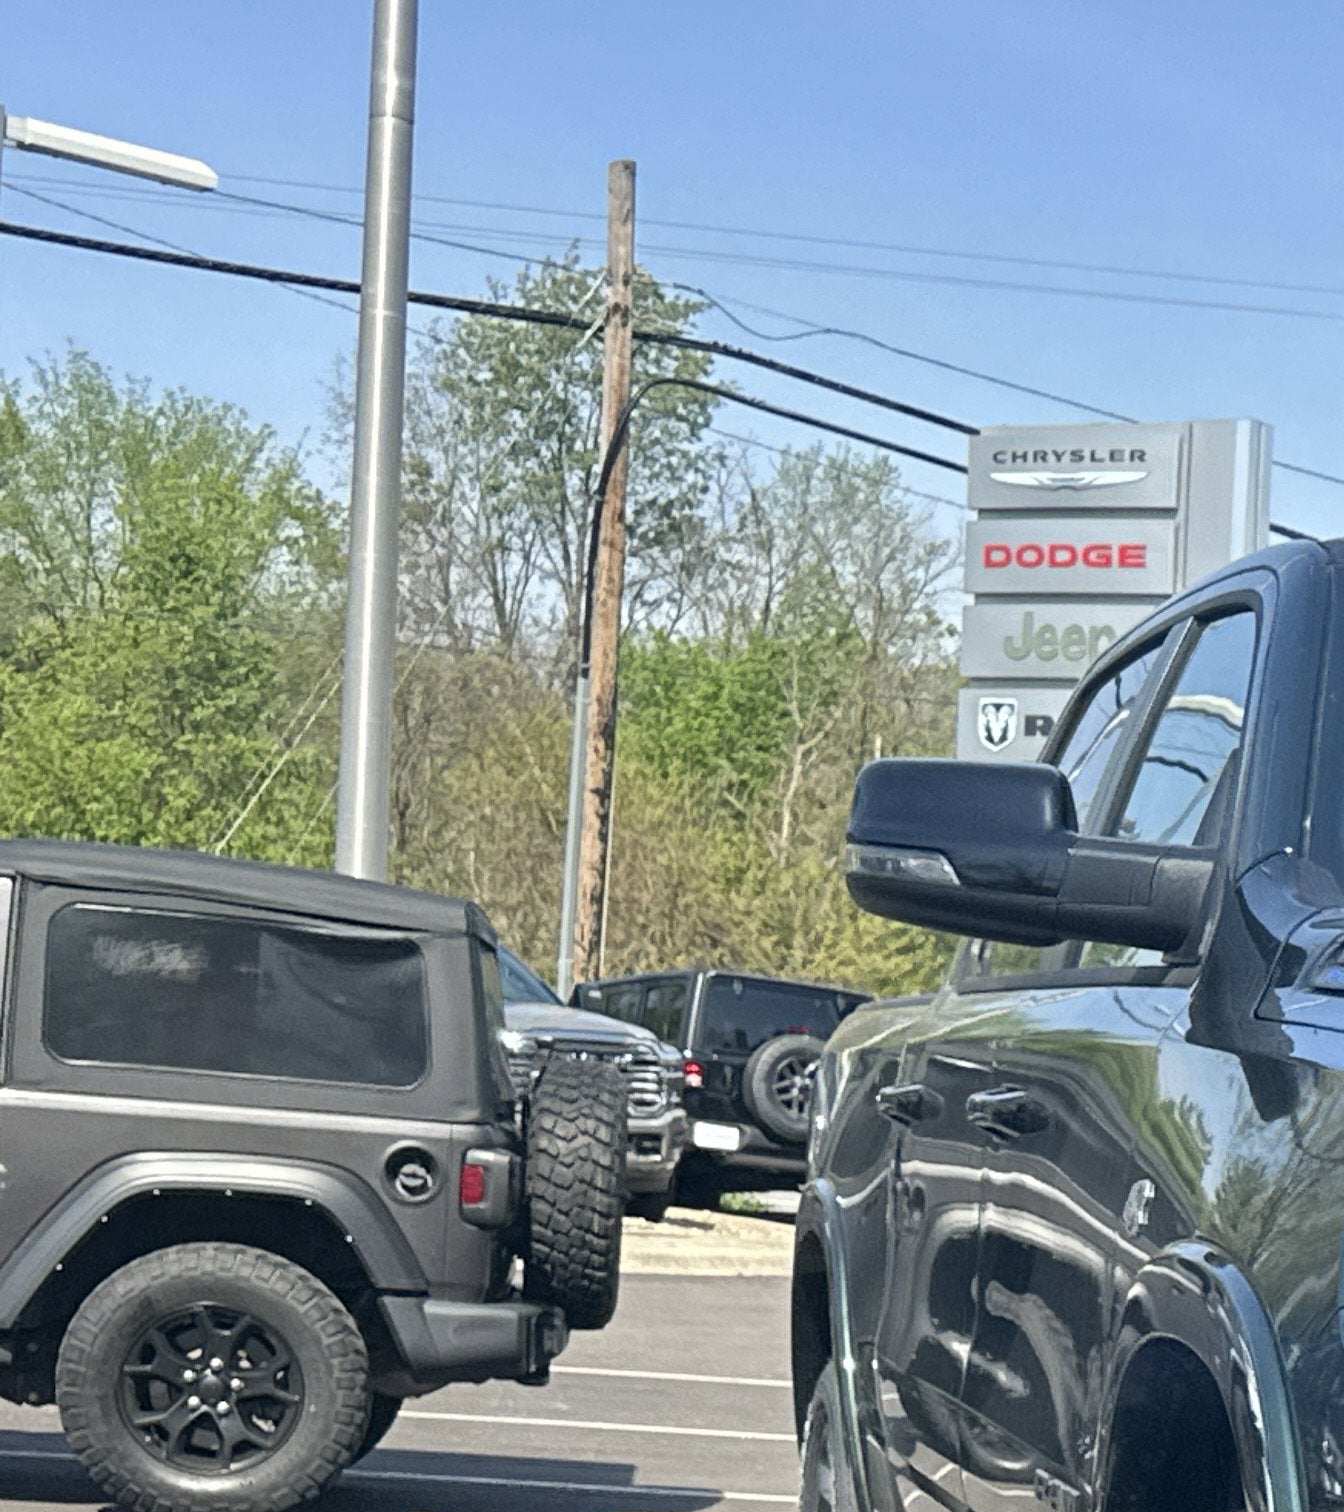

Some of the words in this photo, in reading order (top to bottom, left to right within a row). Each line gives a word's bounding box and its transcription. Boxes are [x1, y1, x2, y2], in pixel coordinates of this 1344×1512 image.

[992, 449, 1148, 465] CHRYSLER
[984, 543, 1147, 568] DODGE
[1003, 611, 1117, 663] Jeep
